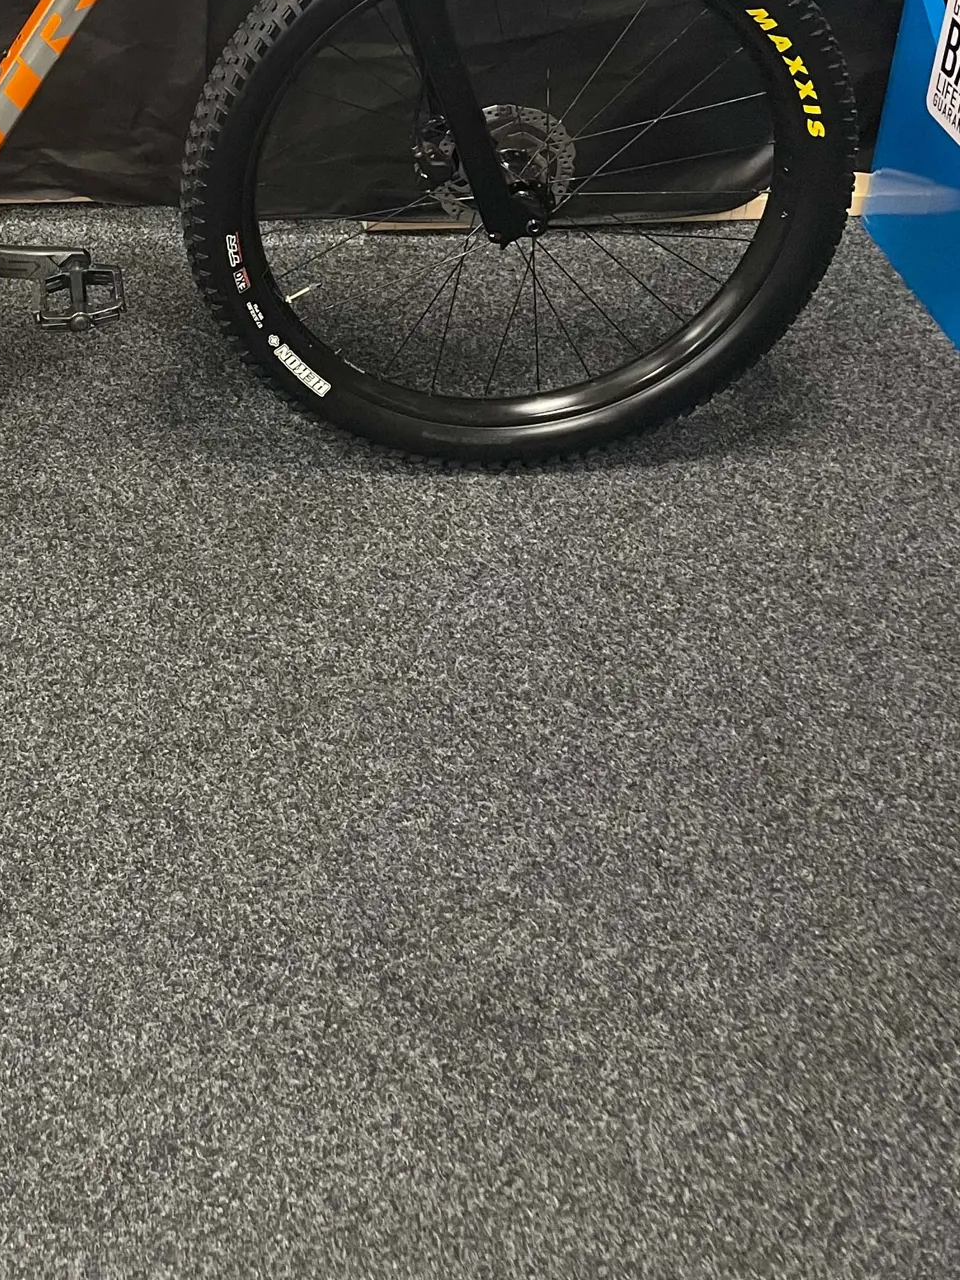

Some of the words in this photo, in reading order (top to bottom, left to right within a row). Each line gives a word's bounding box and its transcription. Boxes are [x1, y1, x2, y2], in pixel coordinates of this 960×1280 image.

[744, 7, 827, 138] MAXXIS
[234, 269, 250, 293] EXO
[273, 343, 332, 398] REKON
